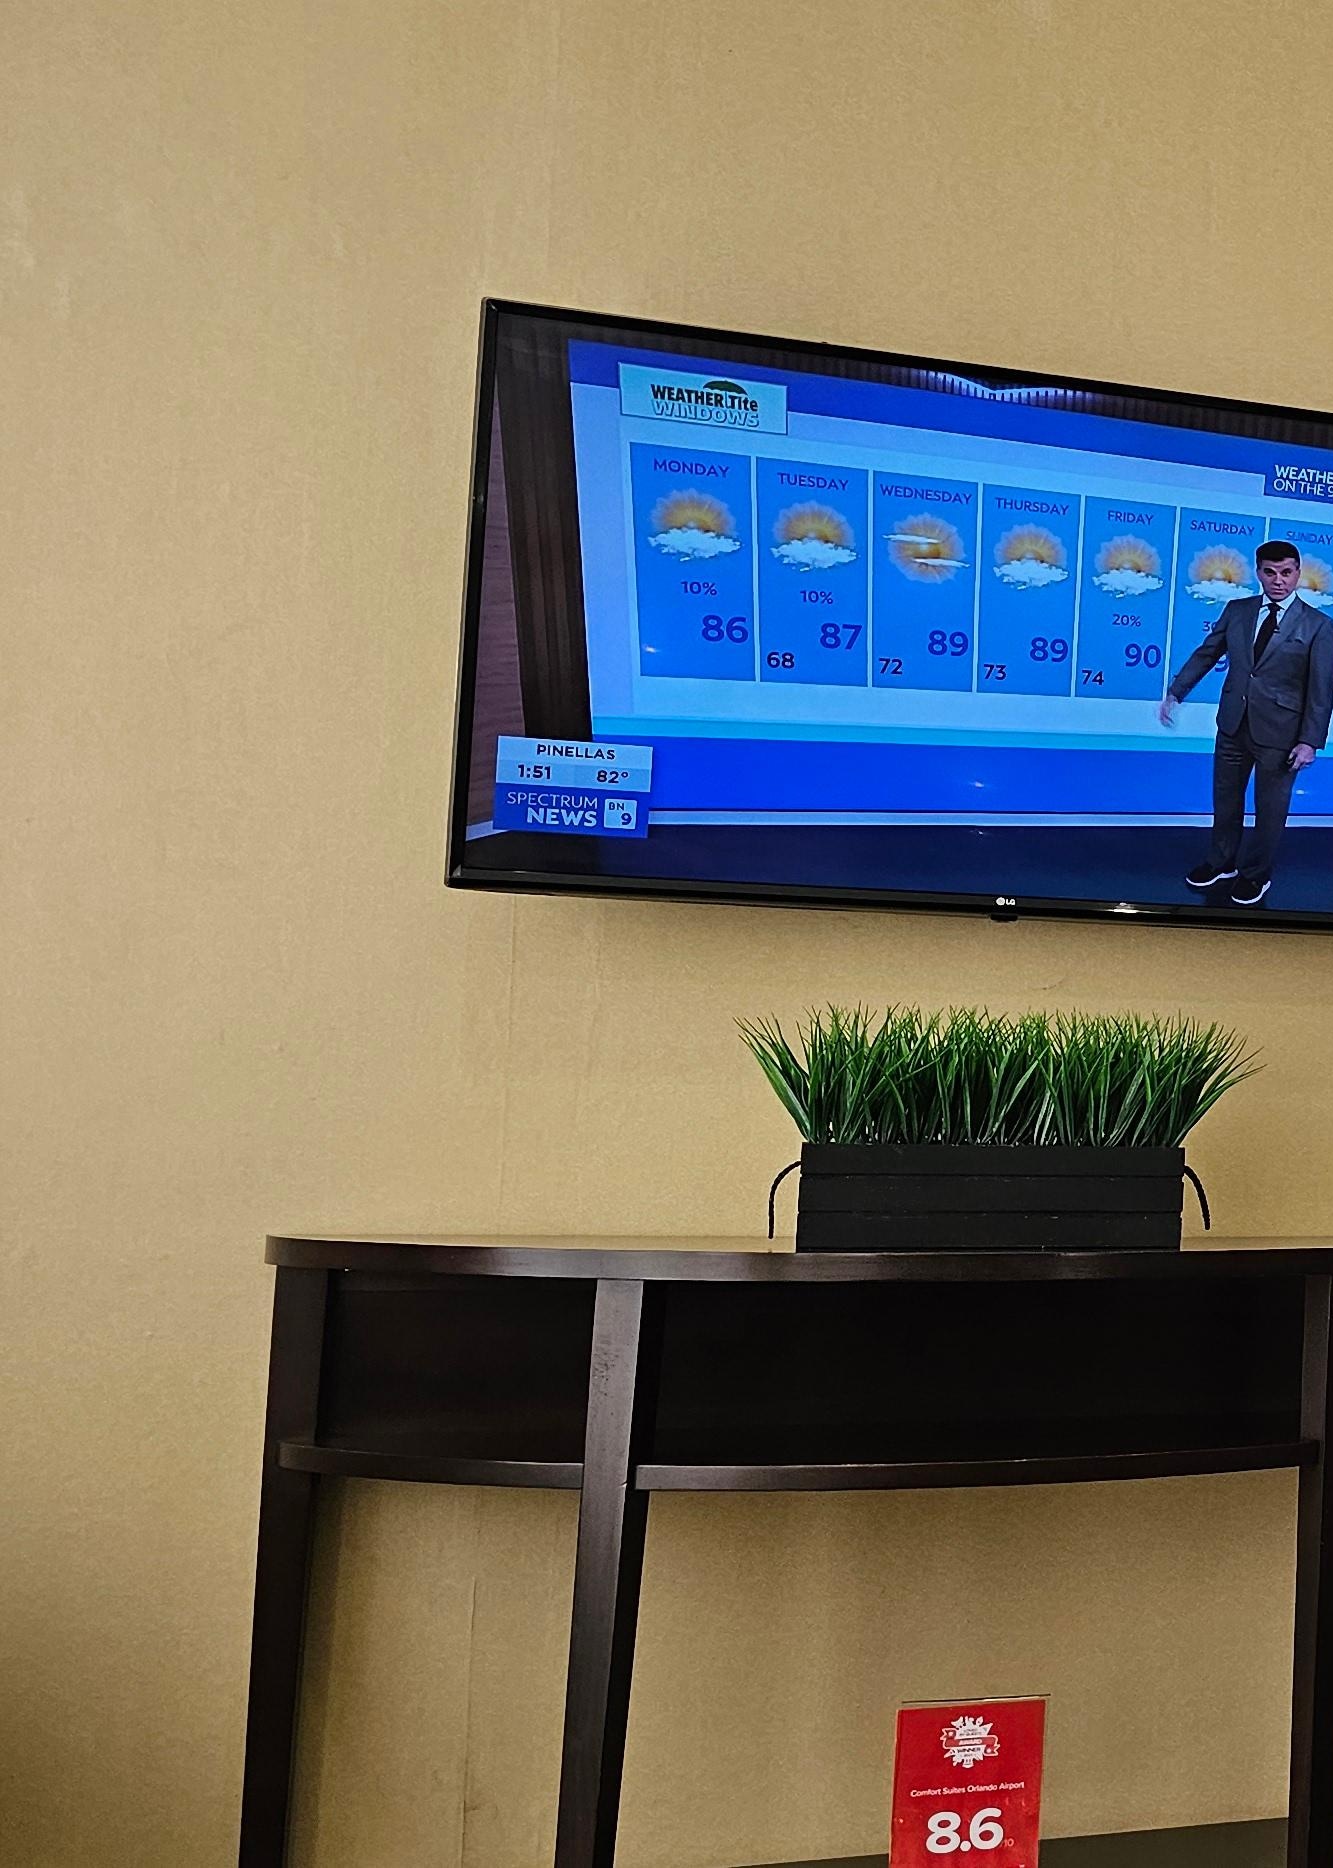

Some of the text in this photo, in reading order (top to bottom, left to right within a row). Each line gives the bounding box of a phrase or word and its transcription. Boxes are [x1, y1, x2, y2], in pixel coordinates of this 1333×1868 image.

[651, 384, 724, 408] WEATHER
[652, 399, 760, 428] WINDOWS
[653, 458, 730, 479] MONDAY
[777, 472, 849, 491] TUESDAY
[1273, 478, 1296, 492] ON
[1298, 481, 1325, 497] THE
[880, 483, 973, 505] WEDNESDAY
[995, 496, 1069, 516] THURSDAY
[1107, 510, 1155, 526] FRIDAY
[1190, 519, 1255, 536] SATURDAY
[1285, 531, 1333, 545] SUNDAY
[681, 581, 718, 597] 10%
[800, 590, 834, 605] 10%
[1112, 613, 1141, 628] 20%
[701, 615, 749, 644] 86
[819, 624, 862, 651] 87
[927, 630, 970, 657] 89
[1029, 637, 1069, 663] 89
[766, 652, 795, 669] 68
[1124, 643, 1162, 669] 90
[878, 658, 903, 675] 72
[983, 664, 1007, 681] 73
[1081, 670, 1105, 687] 74
[536, 743, 615, 760] PINELLAS
[517, 764, 552, 780] 1:51
[507, 791, 598, 809] SPECTRUM
[608, 802, 625, 811] BN
[526, 807, 597, 828] NEWS
[620, 812, 632, 825] 9
[910, 1781, 1025, 1798] Comfort Suites Orlando Airport
[925, 1807, 1004, 1854] 8.6
